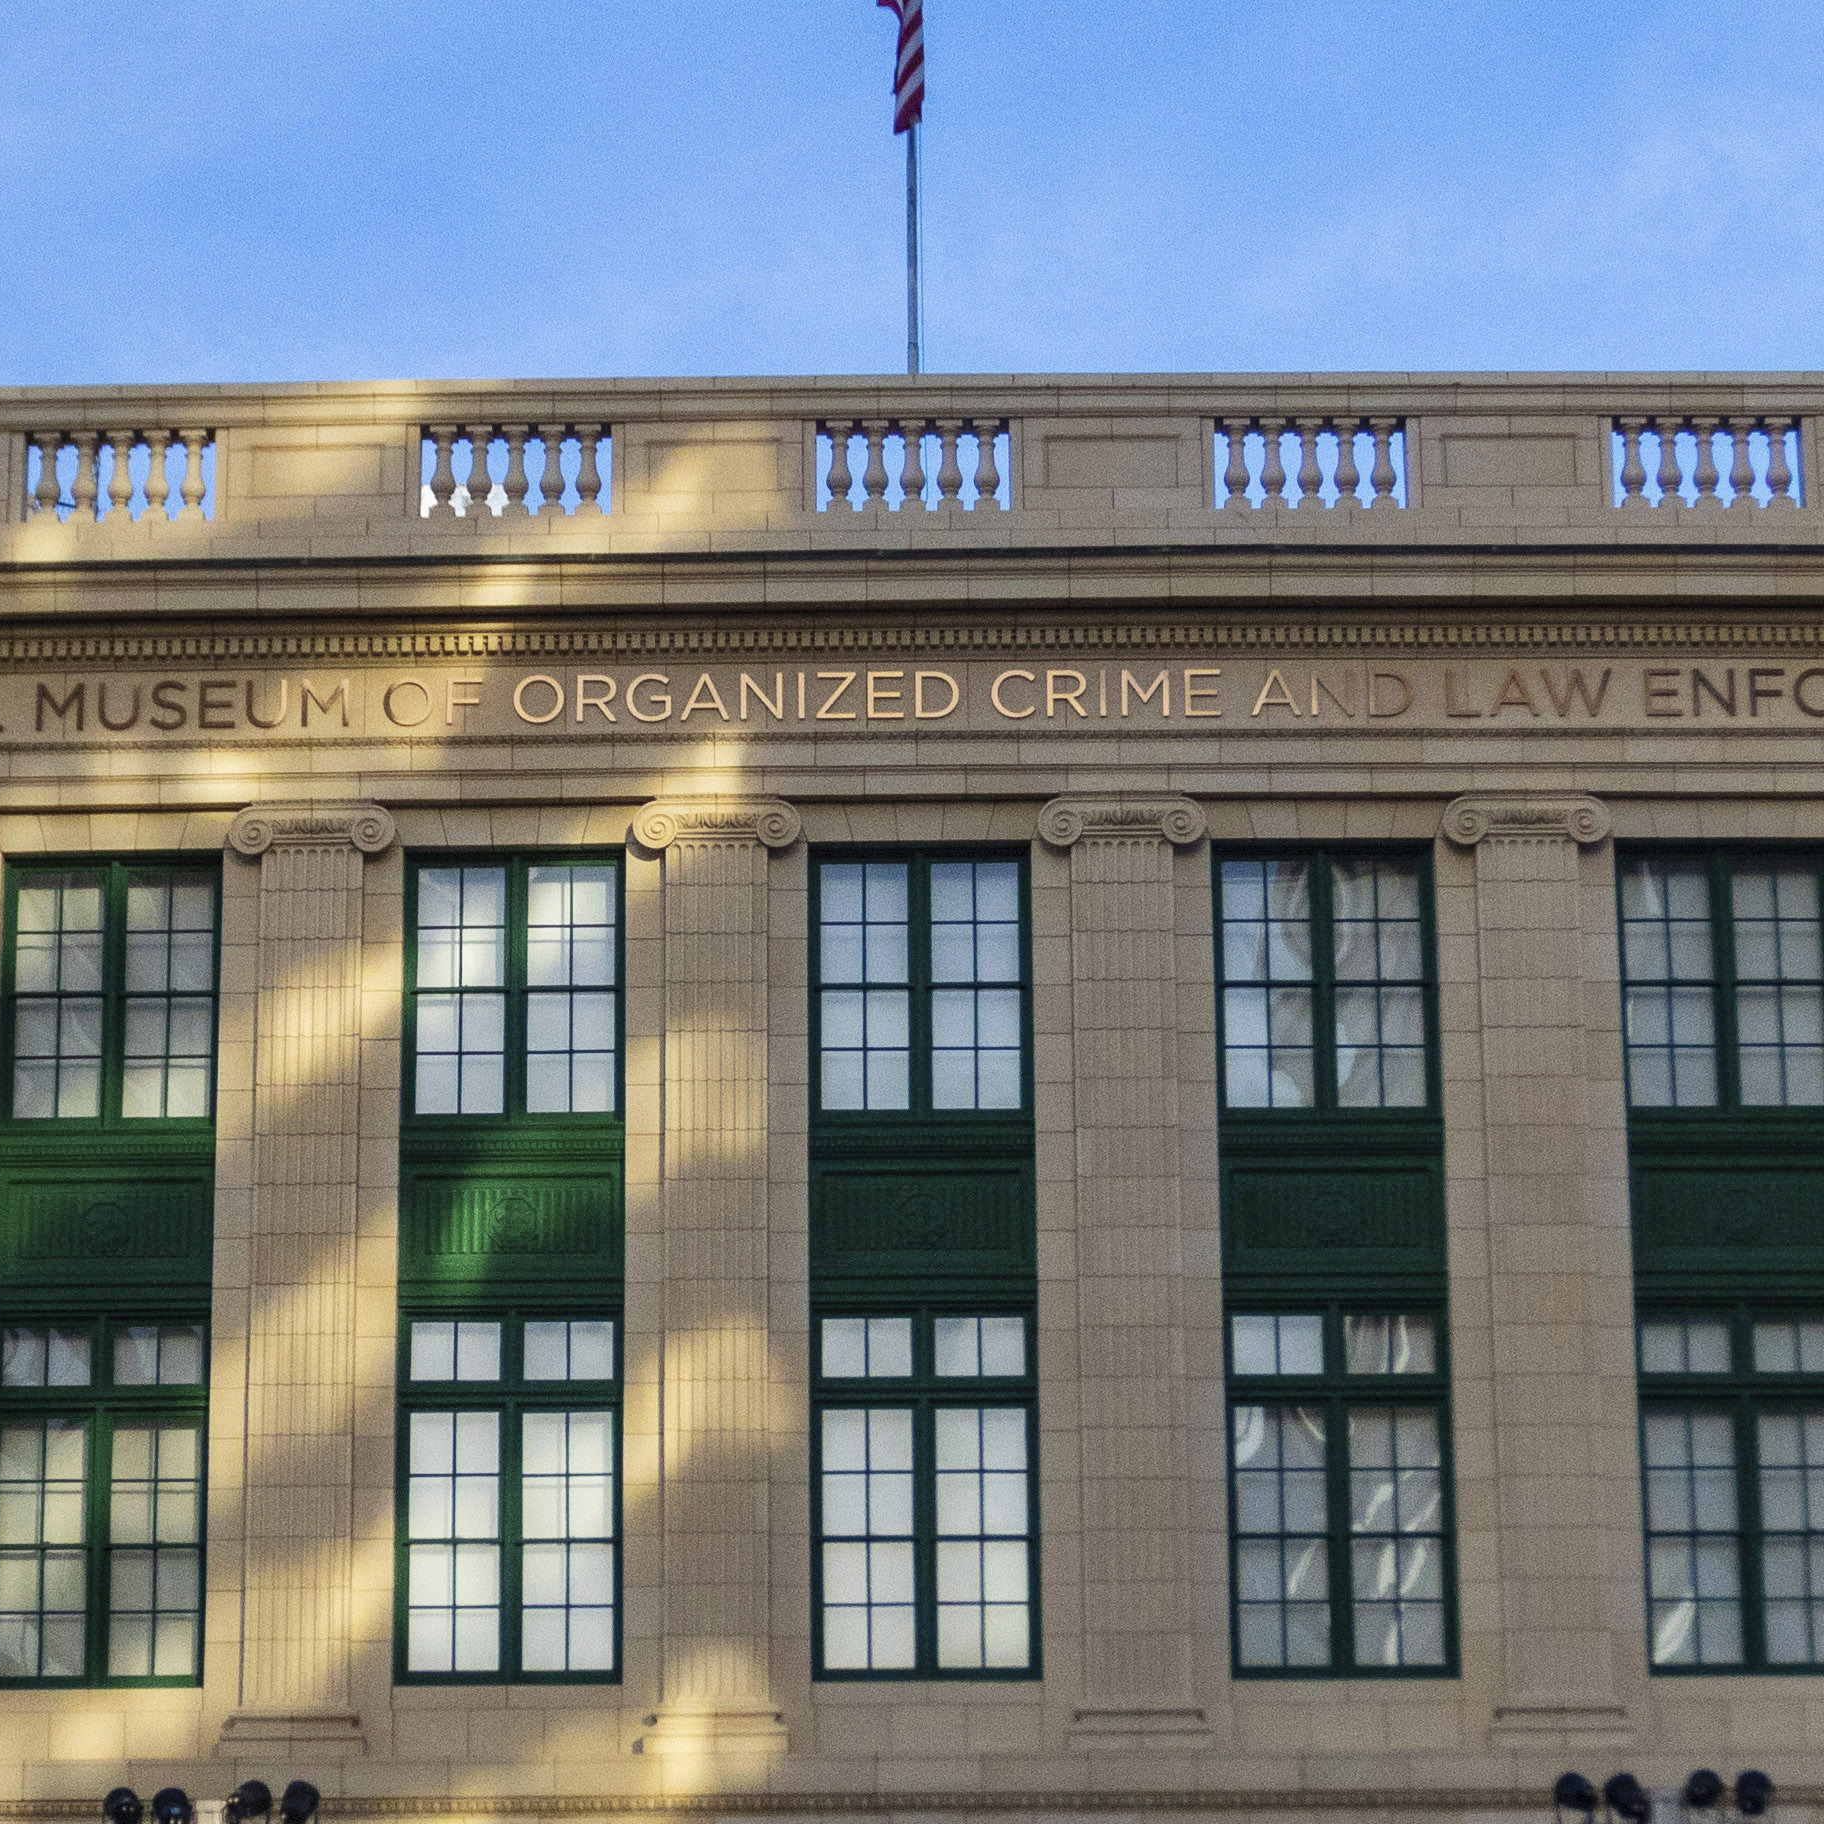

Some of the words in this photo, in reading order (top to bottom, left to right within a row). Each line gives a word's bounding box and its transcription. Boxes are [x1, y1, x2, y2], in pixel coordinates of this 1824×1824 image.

[34, 677, 349, 732] MUSEUM
[382, 677, 484, 728] OF
[512, 670, 960, 724] ORGANIZED
[990, 668, 1223, 719] CRIME
[1250, 668, 1414, 718] AND
[1444, 667, 1613, 719] LAW
